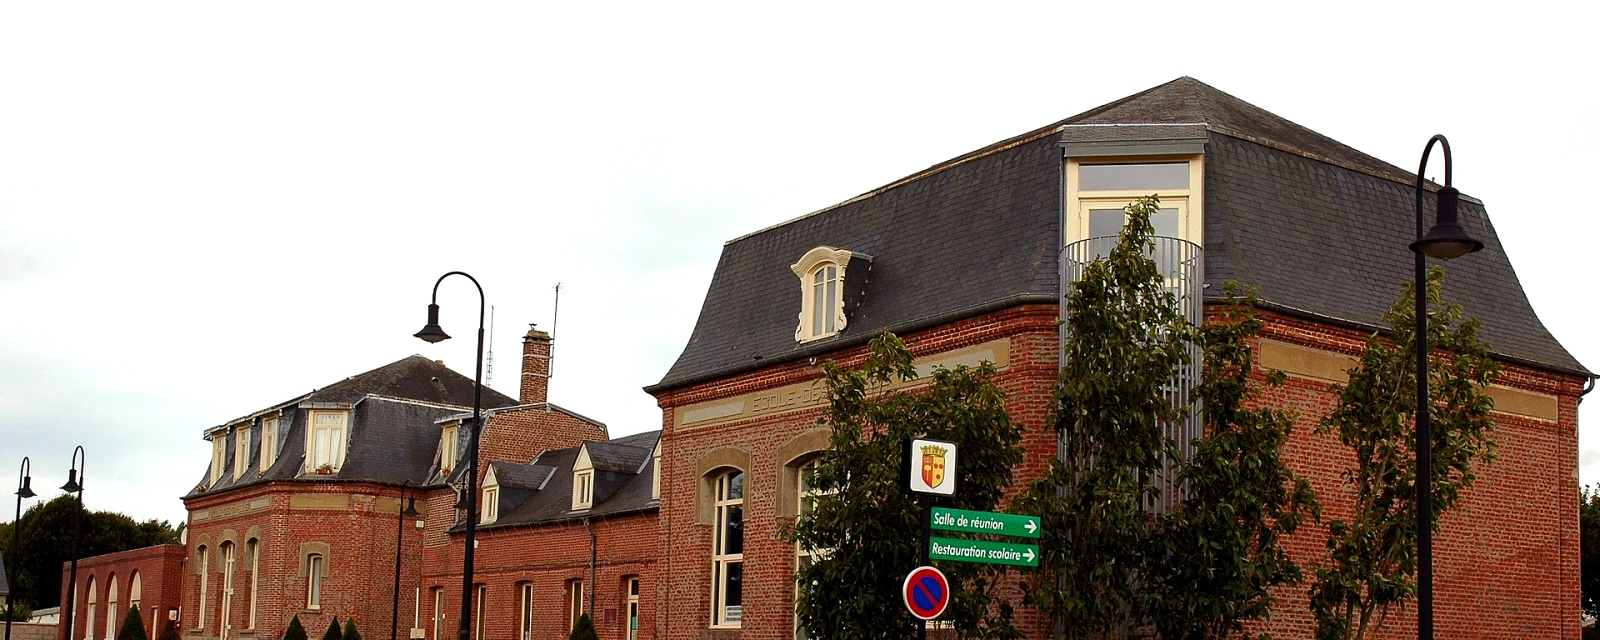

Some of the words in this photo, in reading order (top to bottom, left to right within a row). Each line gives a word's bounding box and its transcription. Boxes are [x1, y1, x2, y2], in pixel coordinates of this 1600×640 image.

[933, 512, 955, 526] Salle
[957, 514, 968, 527] de
[970, 517, 1004, 530] réunion
[932, 542, 986, 558] Restauration
[988, 547, 1021, 561] scolaire
